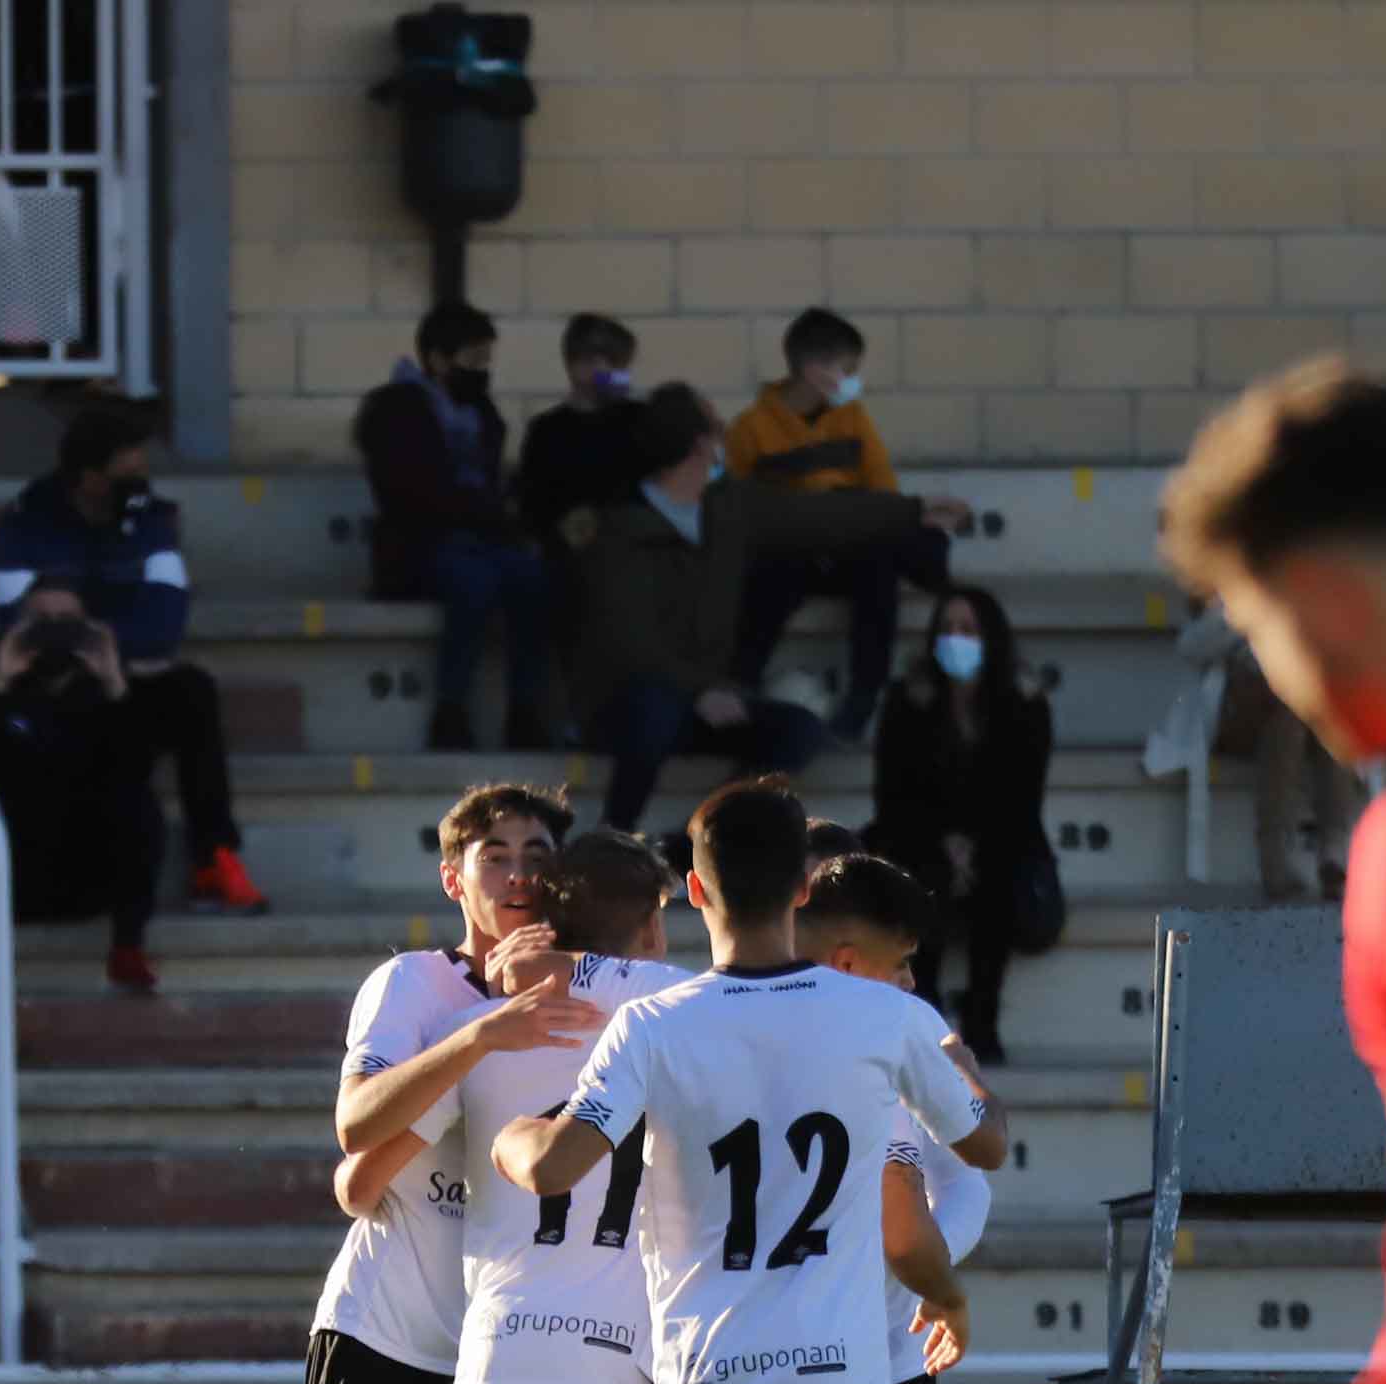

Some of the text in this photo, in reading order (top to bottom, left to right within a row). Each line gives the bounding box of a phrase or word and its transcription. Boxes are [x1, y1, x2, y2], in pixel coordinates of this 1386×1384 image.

[708, 1110, 851, 1271] 12
[505, 1311, 637, 1348] gruponani
[1034, 1301, 1083, 1331] 91
[714, 1336, 847, 1382] gruponani
